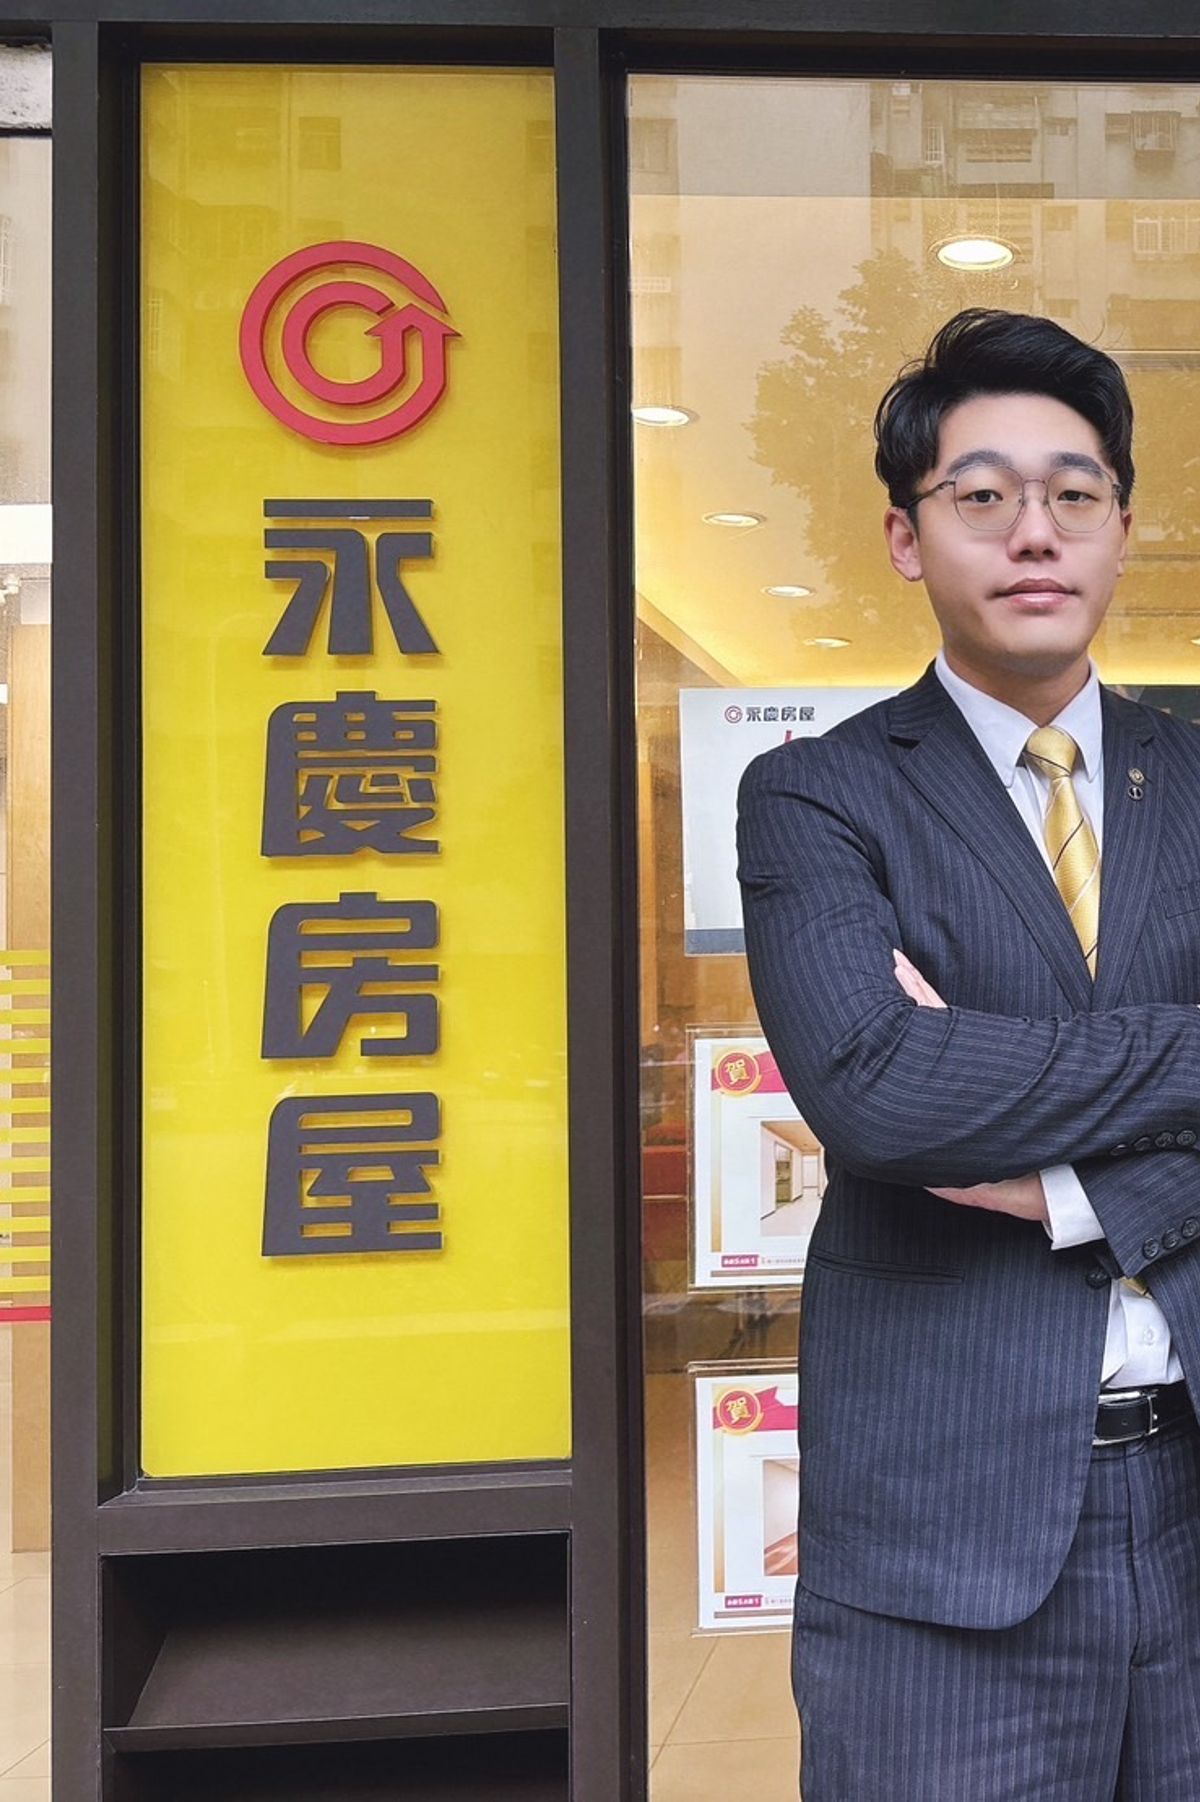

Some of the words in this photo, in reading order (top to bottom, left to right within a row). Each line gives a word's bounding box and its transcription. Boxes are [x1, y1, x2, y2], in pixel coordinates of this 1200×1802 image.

[747, 706, 815, 722] 永慶房屋
[262, 498, 444, 1257] 永慶房屋
[725, 1058, 750, 1085] 賀
[727, 1396, 752, 1425] 賀
